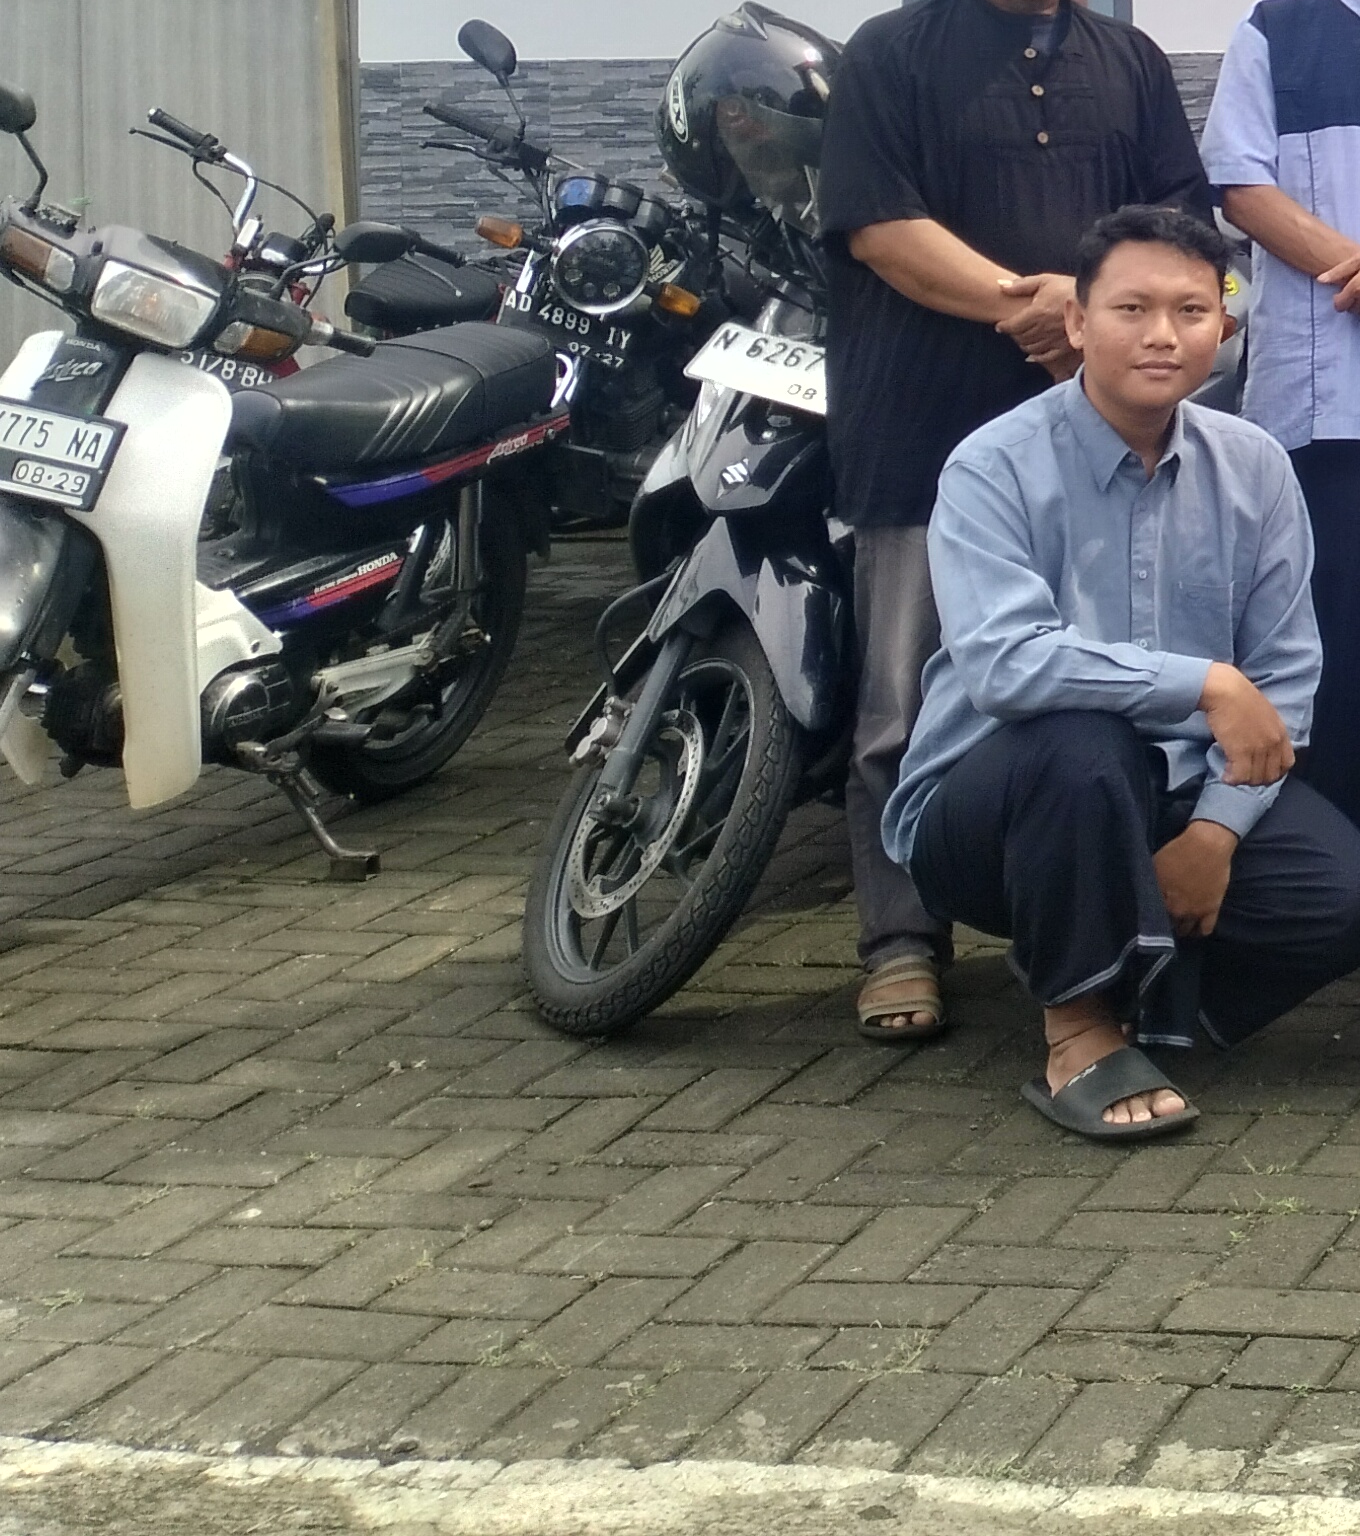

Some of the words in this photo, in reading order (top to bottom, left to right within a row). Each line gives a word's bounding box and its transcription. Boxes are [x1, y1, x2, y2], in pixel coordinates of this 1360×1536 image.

[648, 258, 679, 283] HONDA
[505, 287, 532, 313] AD
[537, 302, 591, 335] 4899
[607, 326, 632, 350] IY
[66, 338, 101, 351] HONDA
[712, 329, 739, 351] N
[745, 337, 827, 373] 6267
[0, 410, 54, 449] 775
[65, 427, 103, 463] NA
[356, 551, 398, 576] HONDA
